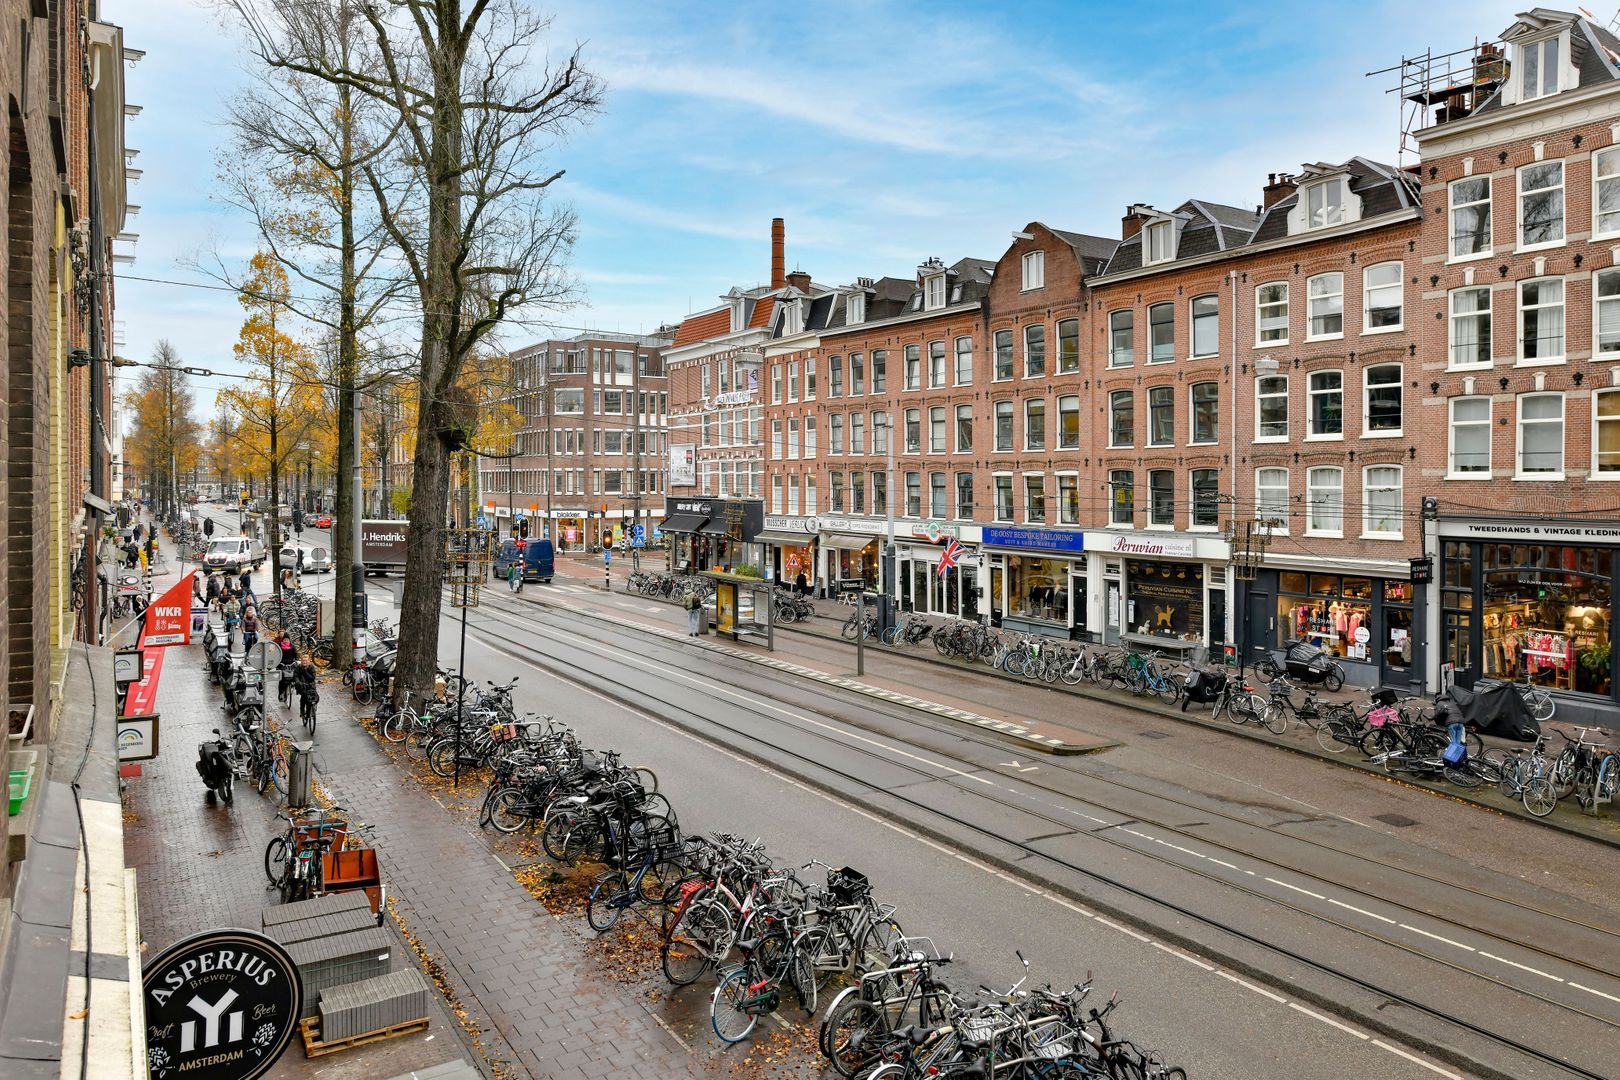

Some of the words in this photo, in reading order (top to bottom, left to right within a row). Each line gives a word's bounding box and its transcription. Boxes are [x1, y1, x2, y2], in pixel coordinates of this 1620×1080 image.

[810, 519, 816, 530] 3
[1468, 525, 1531, 534] TWEEDEHANDS
[369, 531, 406, 541] Hendriks
[990, 529, 998, 537] DE
[999, 530, 1013, 538] OOST
[1013, 531, 1039, 540] BESPOKE
[1040, 532, 1073, 542] TAILORING
[1113, 536, 1163, 554] Peruvian
[1137, 584, 1163, 592] PERUVIAN
[1163, 586, 1185, 594] CUISINE
[154, 606, 182, 617] WKR
[1524, 631, 1564, 641] RESHARE
[150, 950, 277, 1007] ASPERIUS
[190, 972, 238, 990] Brewery
[252, 1003, 277, 1021] Beer
[178, 1050, 244, 1072] AMSTERDAM
